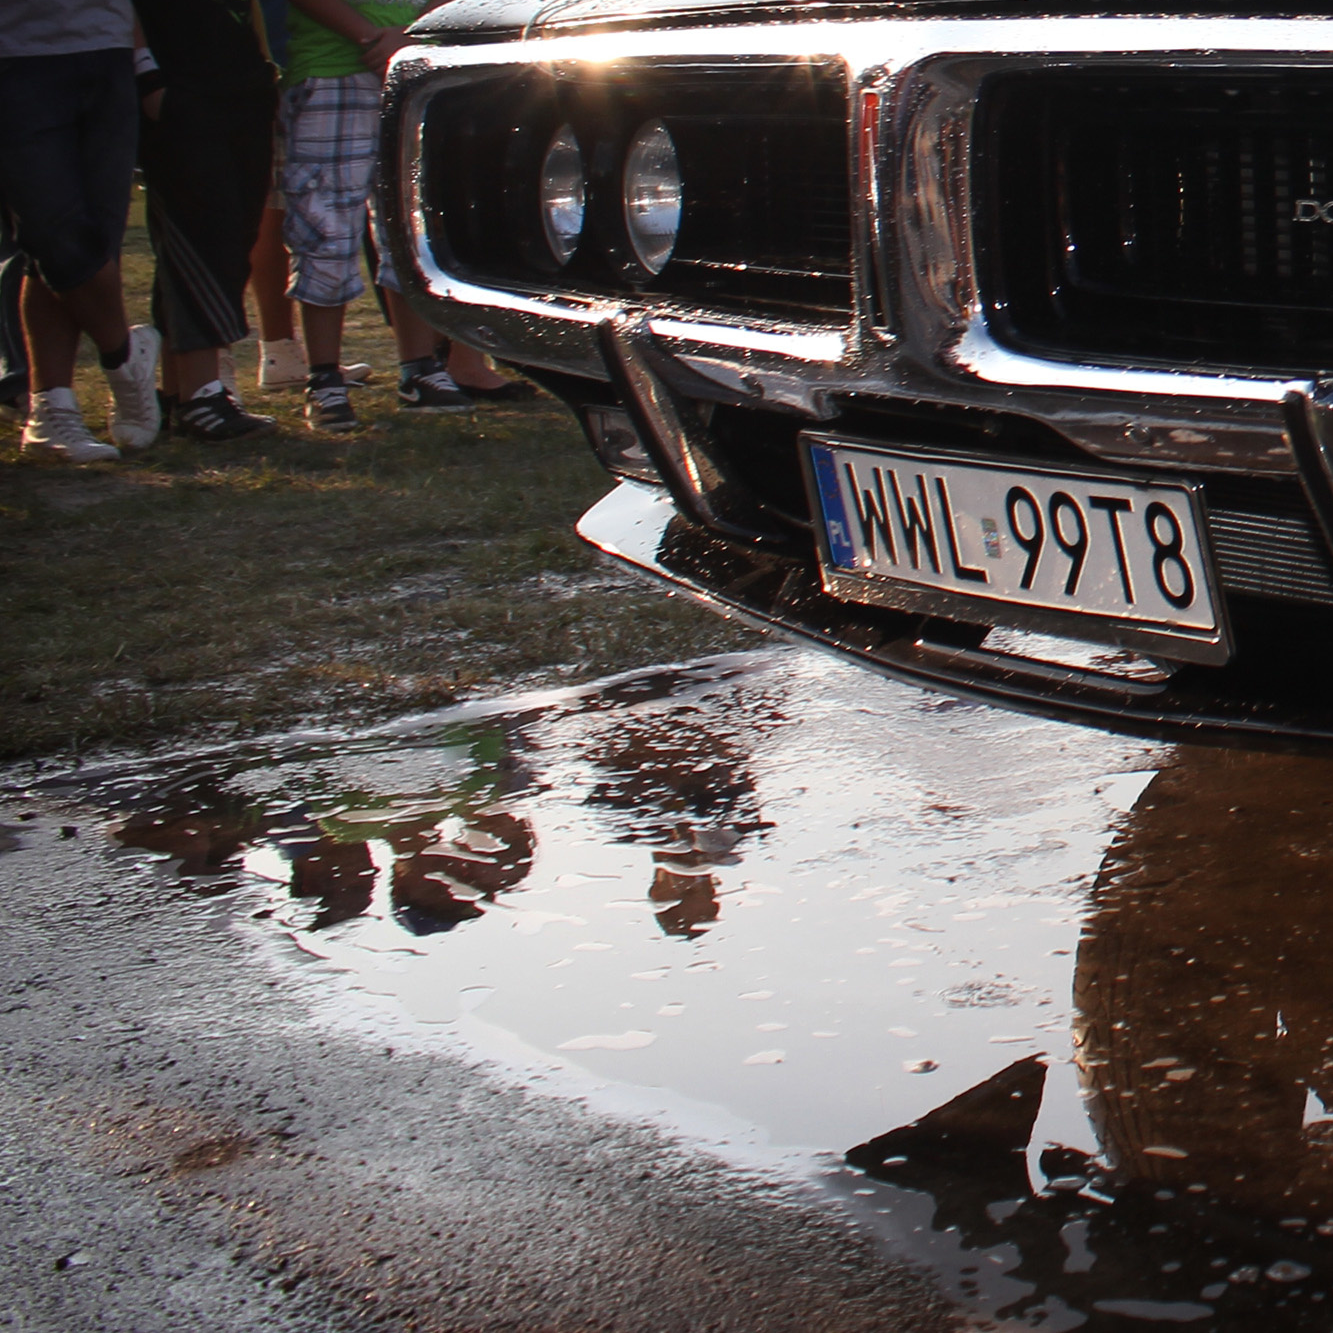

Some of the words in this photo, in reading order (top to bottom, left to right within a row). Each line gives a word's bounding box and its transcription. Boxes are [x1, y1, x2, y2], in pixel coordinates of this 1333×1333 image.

[827, 519, 851, 548] PL
[844, 462, 989, 584] WWL
[1005, 484, 1196, 609] 99T8
